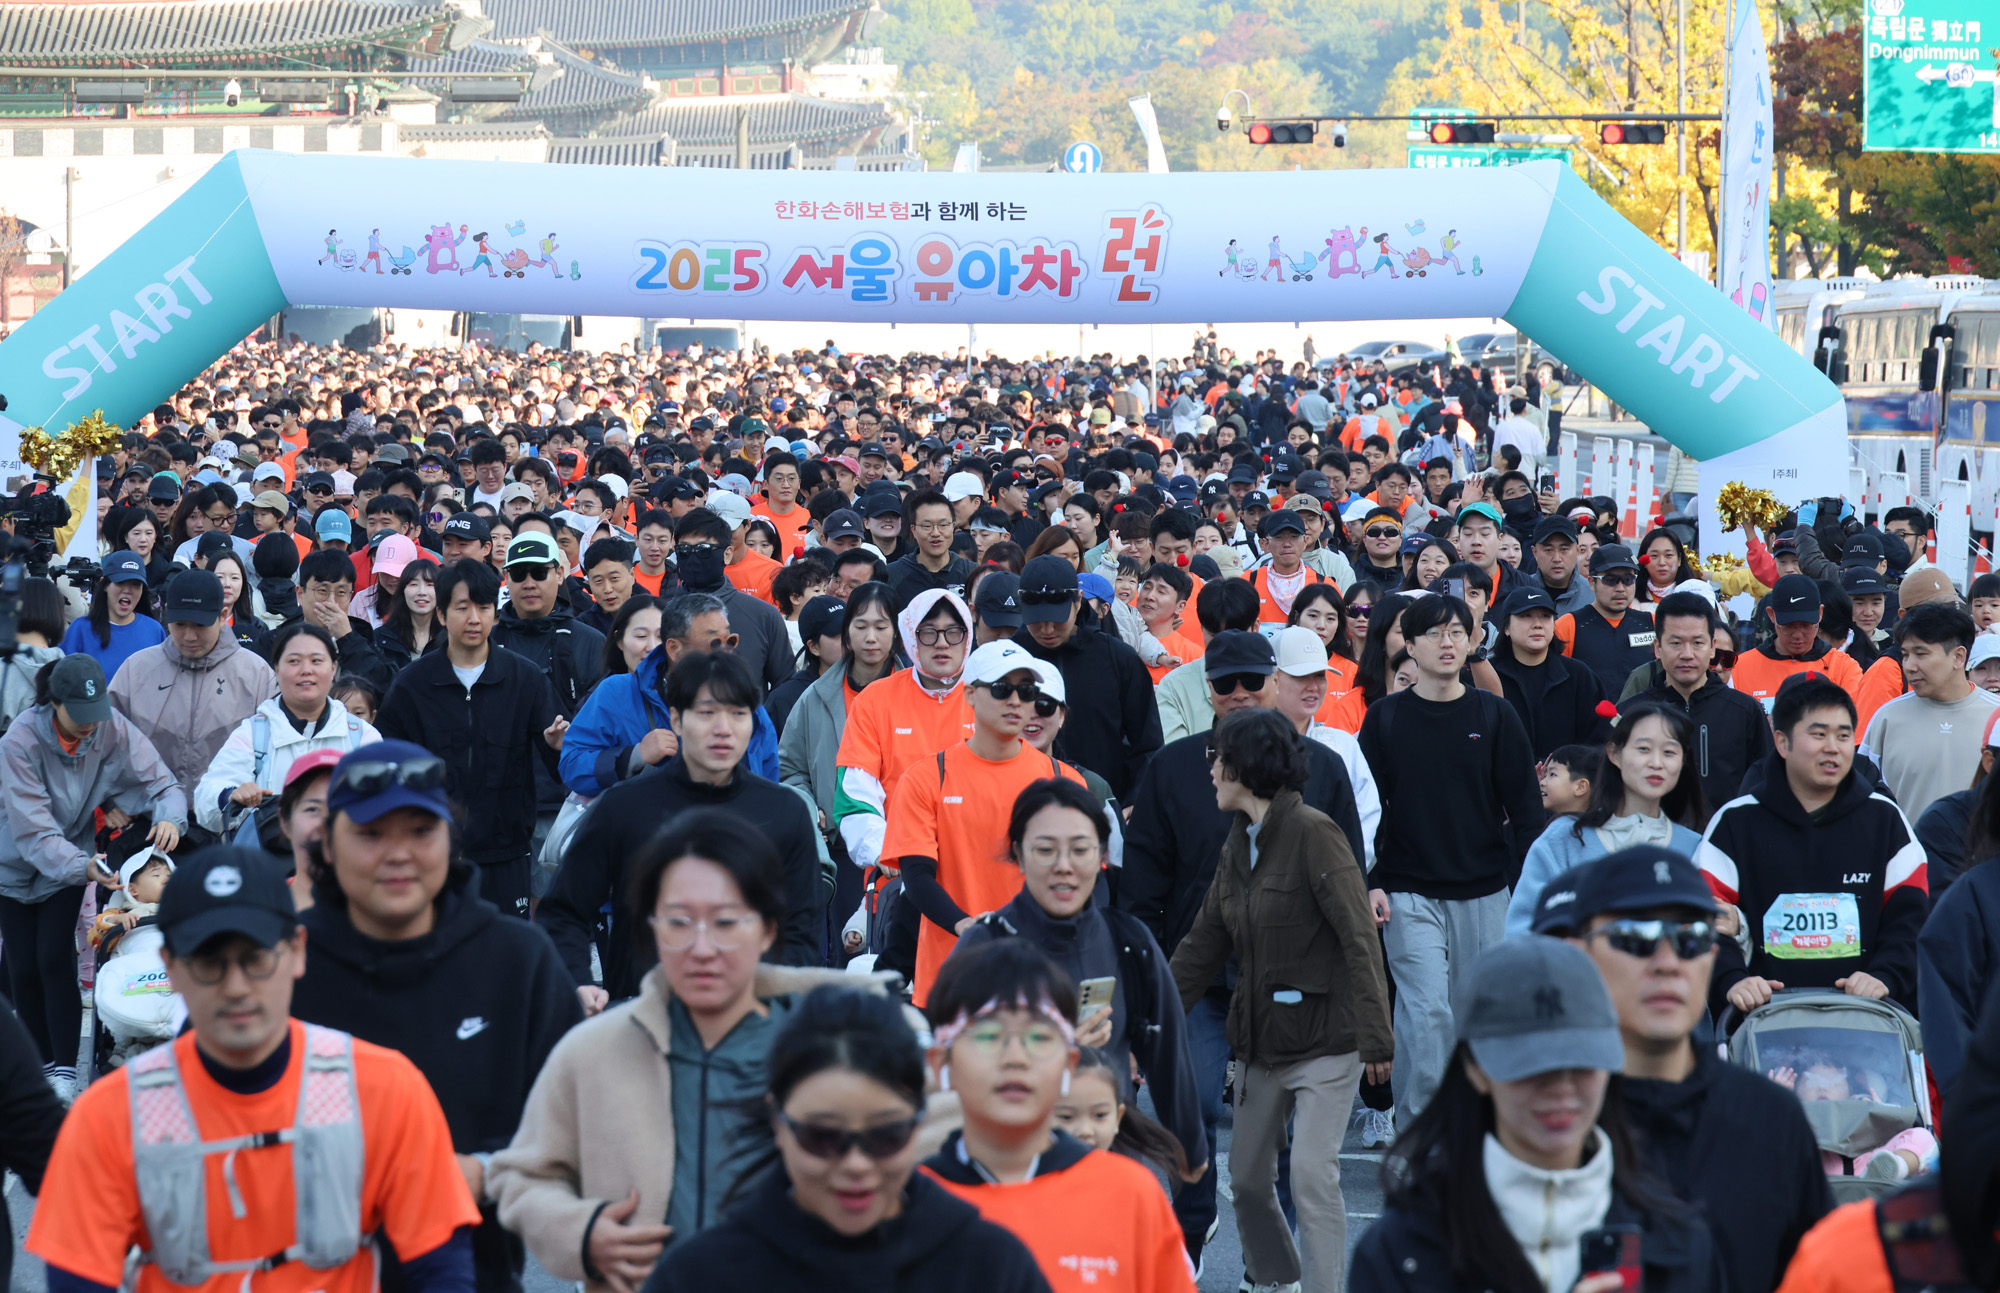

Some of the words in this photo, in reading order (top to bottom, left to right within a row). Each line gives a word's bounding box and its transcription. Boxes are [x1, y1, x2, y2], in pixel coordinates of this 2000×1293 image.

[1870, 16, 1926, 40] 독립문
[1931, 20, 1981, 42] 獨立門
[1869, 43, 1980, 63] Dongnimmun
[1978, 131, 2000, 148] 14
[774, 200, 932, 222] 한화손해보험과
[937, 201, 980, 222] 함께
[986, 201, 1028, 222] 하는
[636, 246, 762, 292] 2025
[782, 238, 896, 301] 서울
[913, 239, 1081, 301] 유아차
[1101, 212, 1162, 302] 런
[42, 255, 213, 402] START
[1576, 265, 1761, 404] START
[445, 519, 472, 530] PING
[385, 546, 396, 560] D
[1842, 873, 1872, 884] LAZY
[515, 897, 529, 908] NIKE
[1783, 912, 1838, 931] 20113
[1796, 936, 1828, 947] 거북이반
